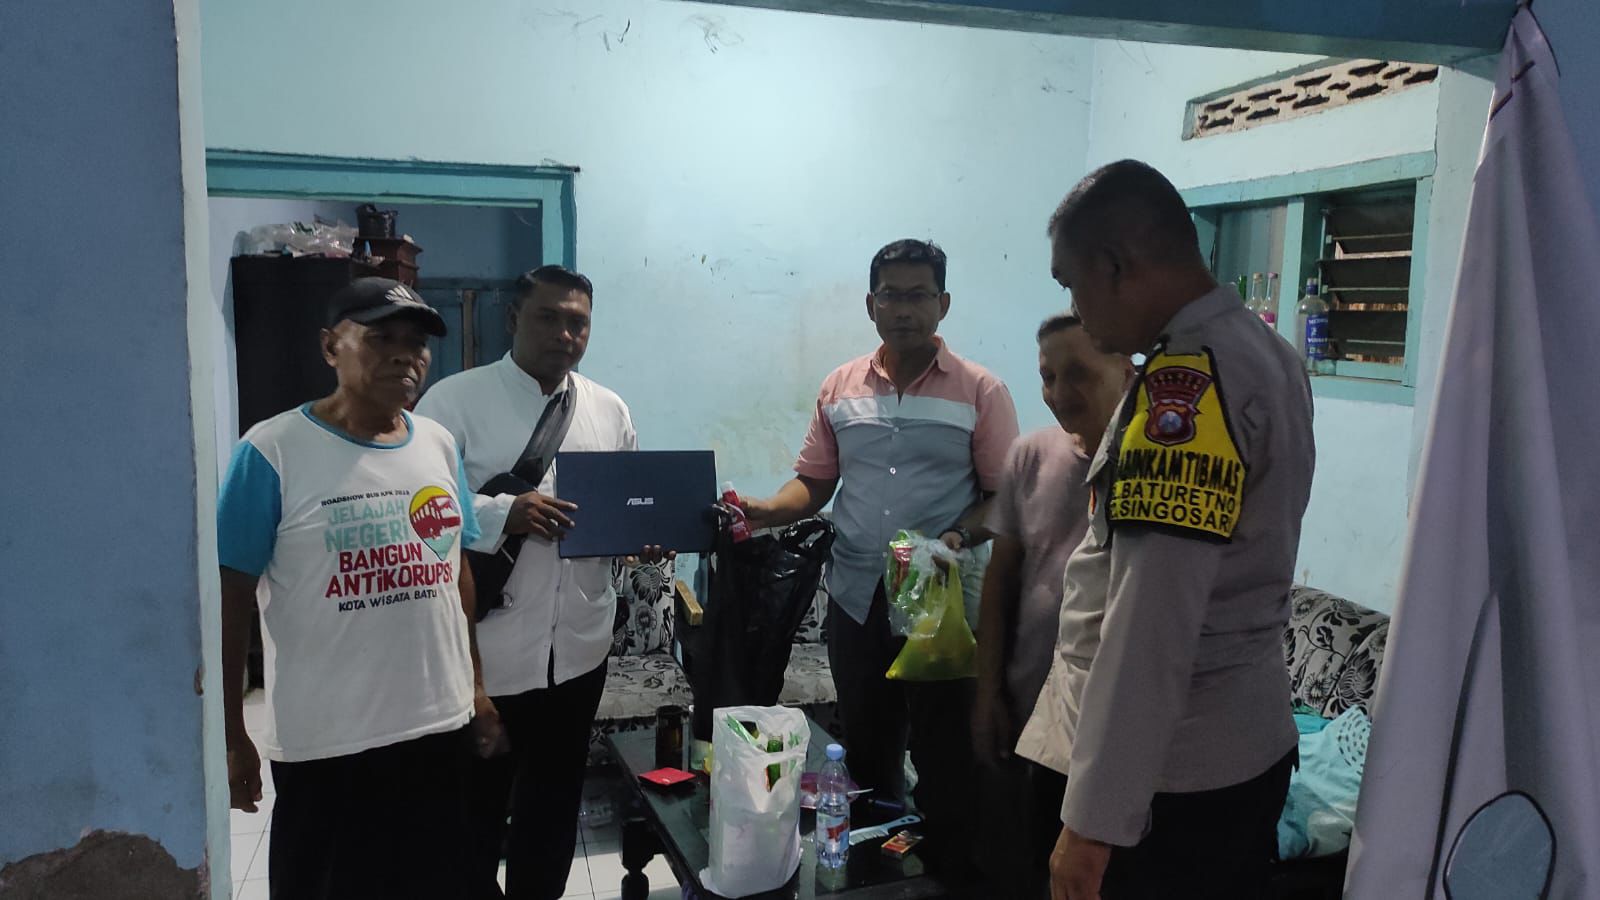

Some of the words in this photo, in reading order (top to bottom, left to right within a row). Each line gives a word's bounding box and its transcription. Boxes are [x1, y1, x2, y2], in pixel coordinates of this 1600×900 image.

[380, 490, 394, 498] KPK
[626, 497, 654, 506] ASUS
[330, 499, 405, 525] JELAJAH
[339, 542, 423, 574] BANGUN
[338, 598, 366, 613] KOTA
[414, 589, 437, 600] BATU
